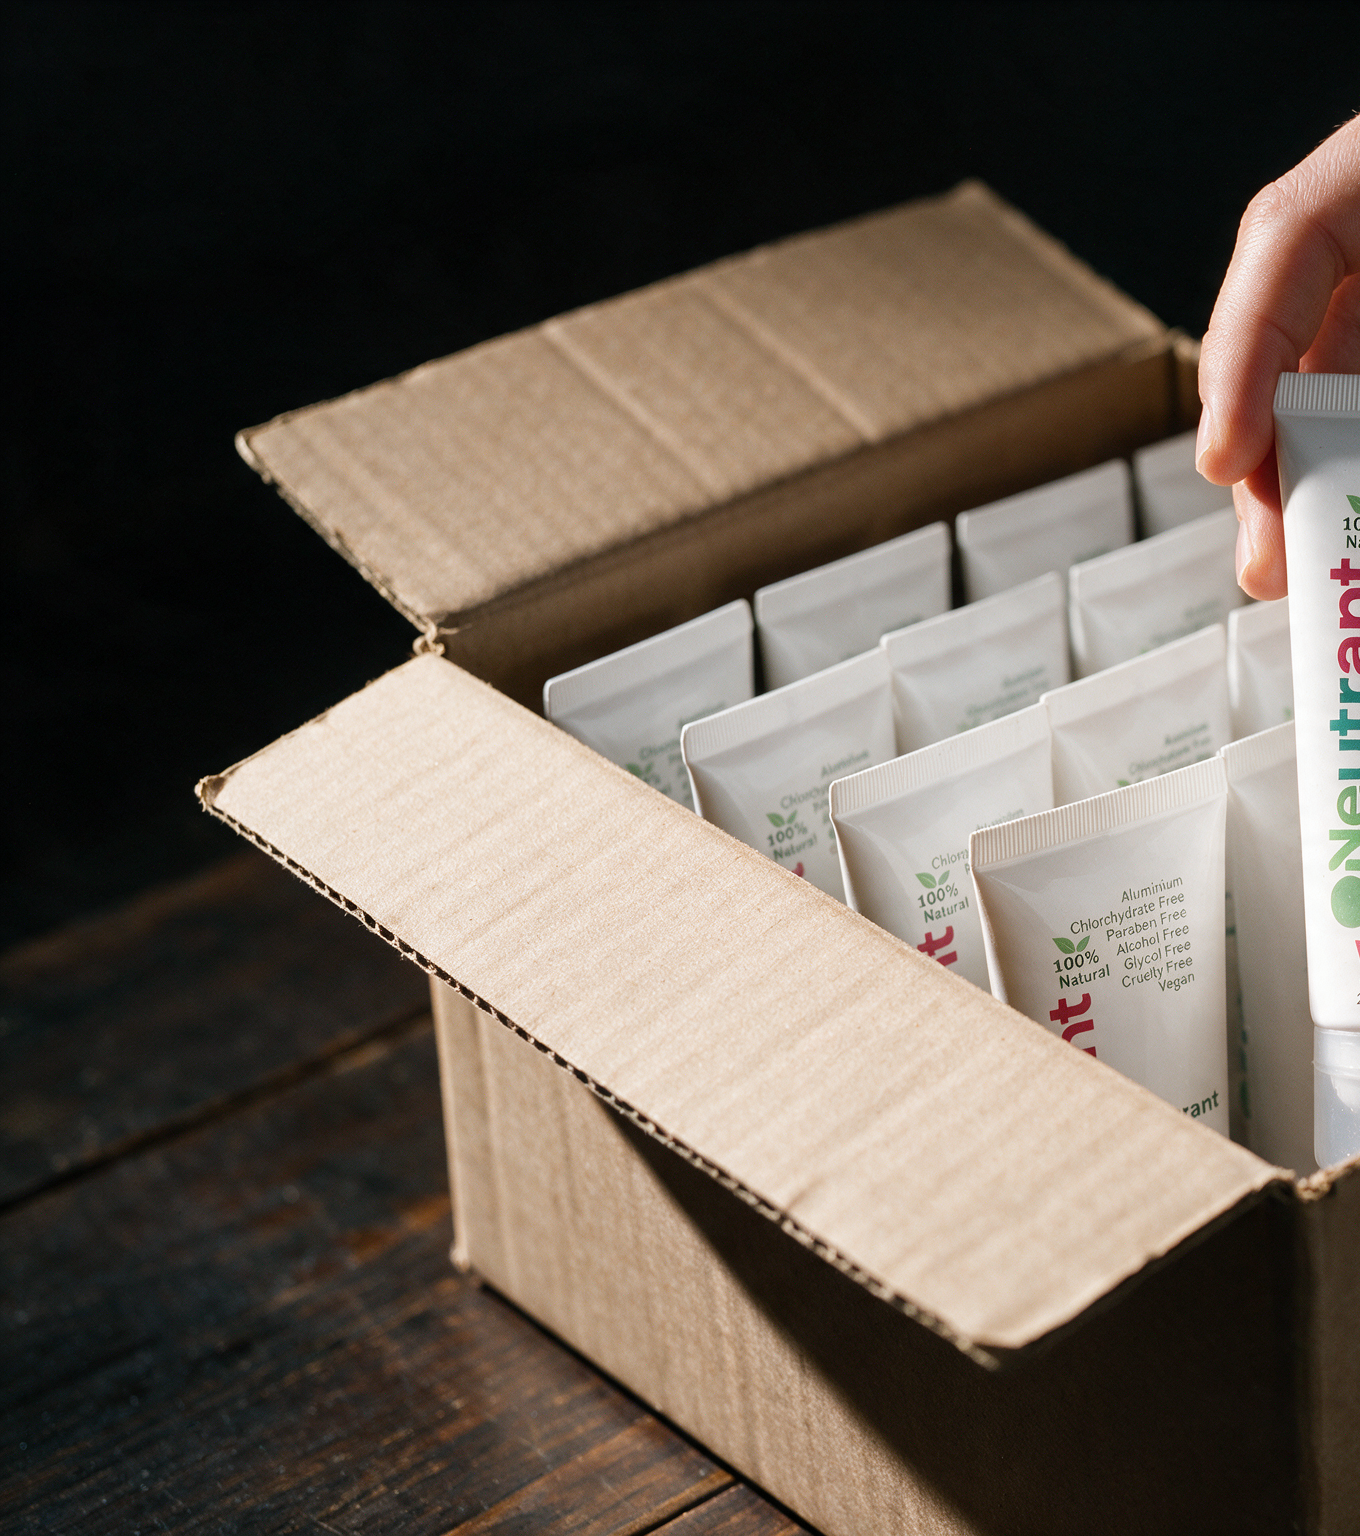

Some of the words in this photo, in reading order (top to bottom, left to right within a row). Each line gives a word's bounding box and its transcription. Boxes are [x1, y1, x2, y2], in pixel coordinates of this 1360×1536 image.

[767, 821, 808, 847] 100%
[917, 883, 959, 908] 100%
[1121, 876, 1183, 903] Aluminium
[923, 896, 970, 924] Natural
[1070, 902, 1156, 935] Chlorchydrate
[1158, 892, 1185, 908] Free
[1106, 919, 1158, 941] Paraben
[1160, 908, 1187, 925] Free
[1116, 932, 1160, 956] Alcohol
[1162, 924, 1190, 941] Free
[1052, 948, 1100, 974] 100%
[1124, 947, 1162, 971] Glycol
[1164, 940, 1192, 957] Free
[1058, 963, 1111, 990] Natural
[1121, 966, 1164, 988] Cruelty
[1166, 956, 1193, 973] Free
[1158, 972, 1195, 992] Vegan
